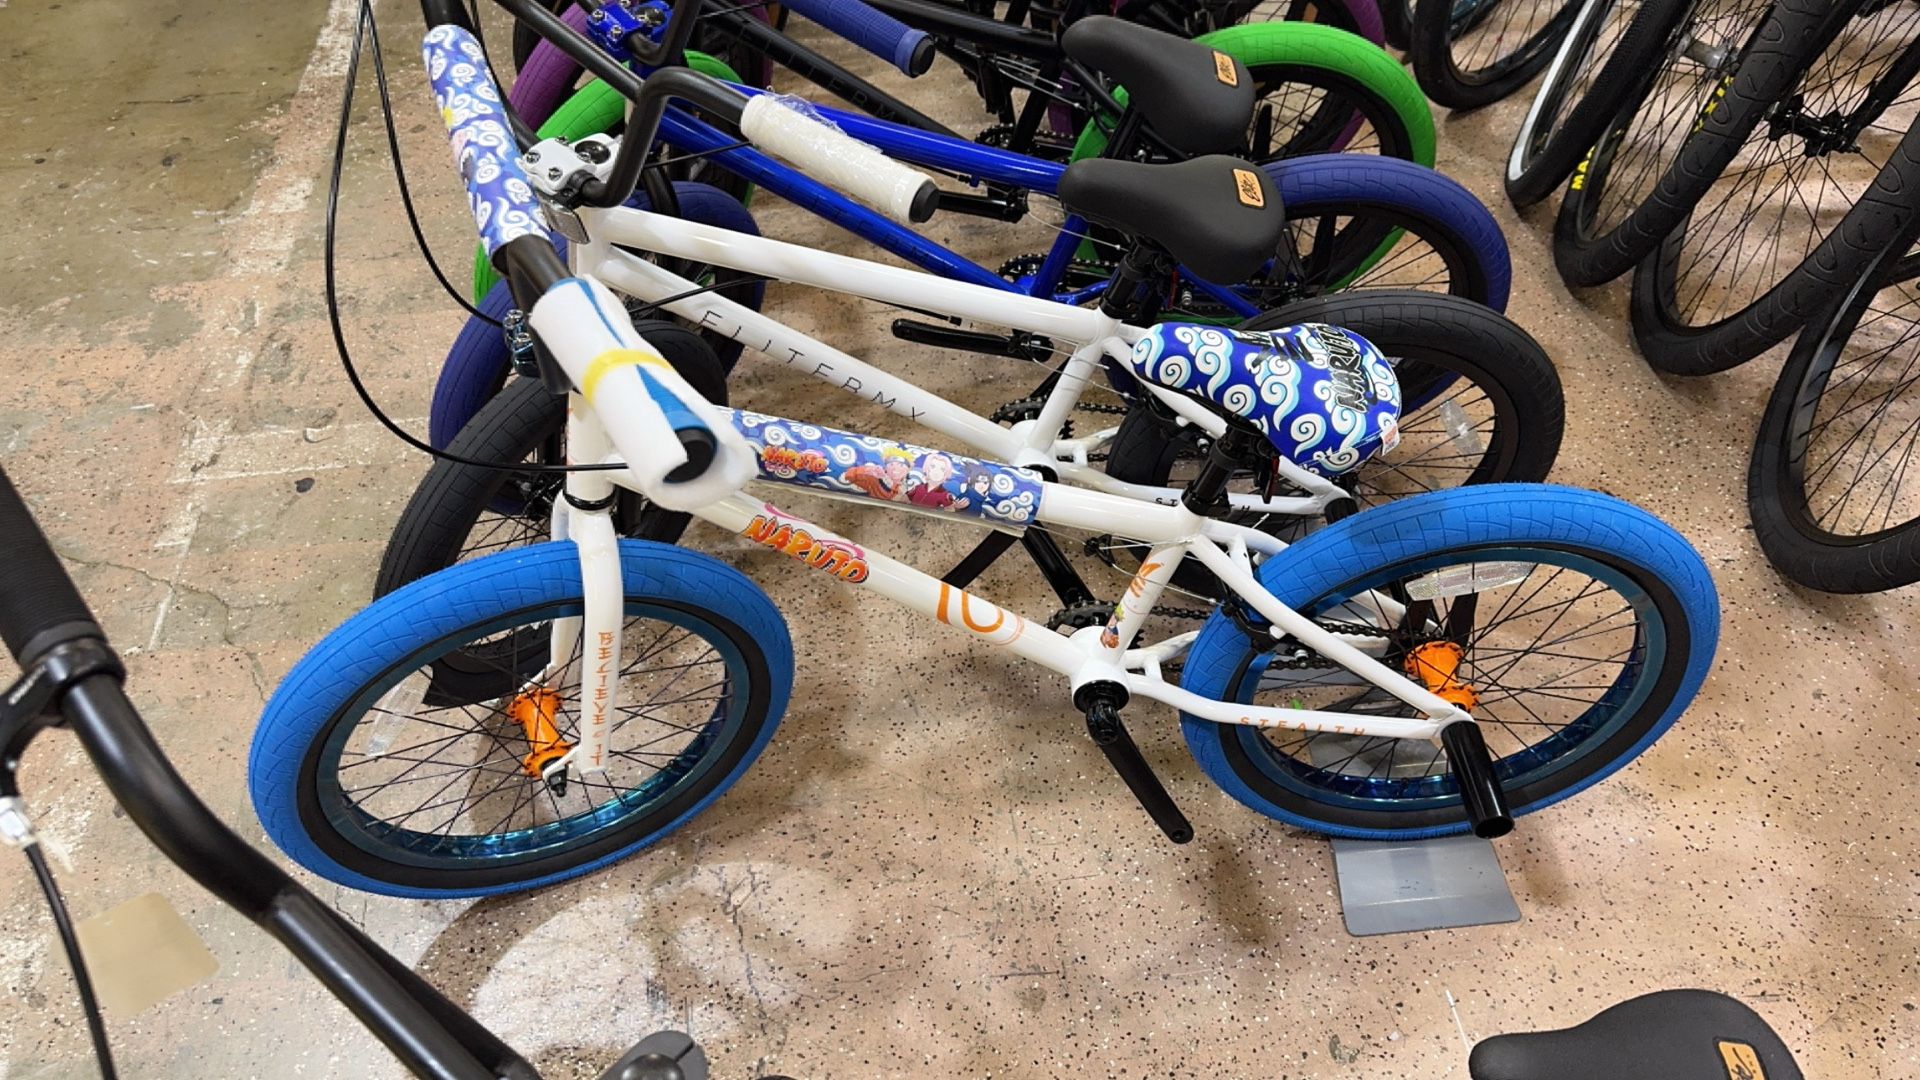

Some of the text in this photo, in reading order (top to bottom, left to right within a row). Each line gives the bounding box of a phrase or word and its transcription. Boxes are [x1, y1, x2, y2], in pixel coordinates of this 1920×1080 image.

[1315, 324, 1369, 414] NARUTO
[739, 514, 869, 583] NARUTO
[590, 631, 615, 766] BELIEVE IT
[1240, 716, 1366, 737] STEALTH
